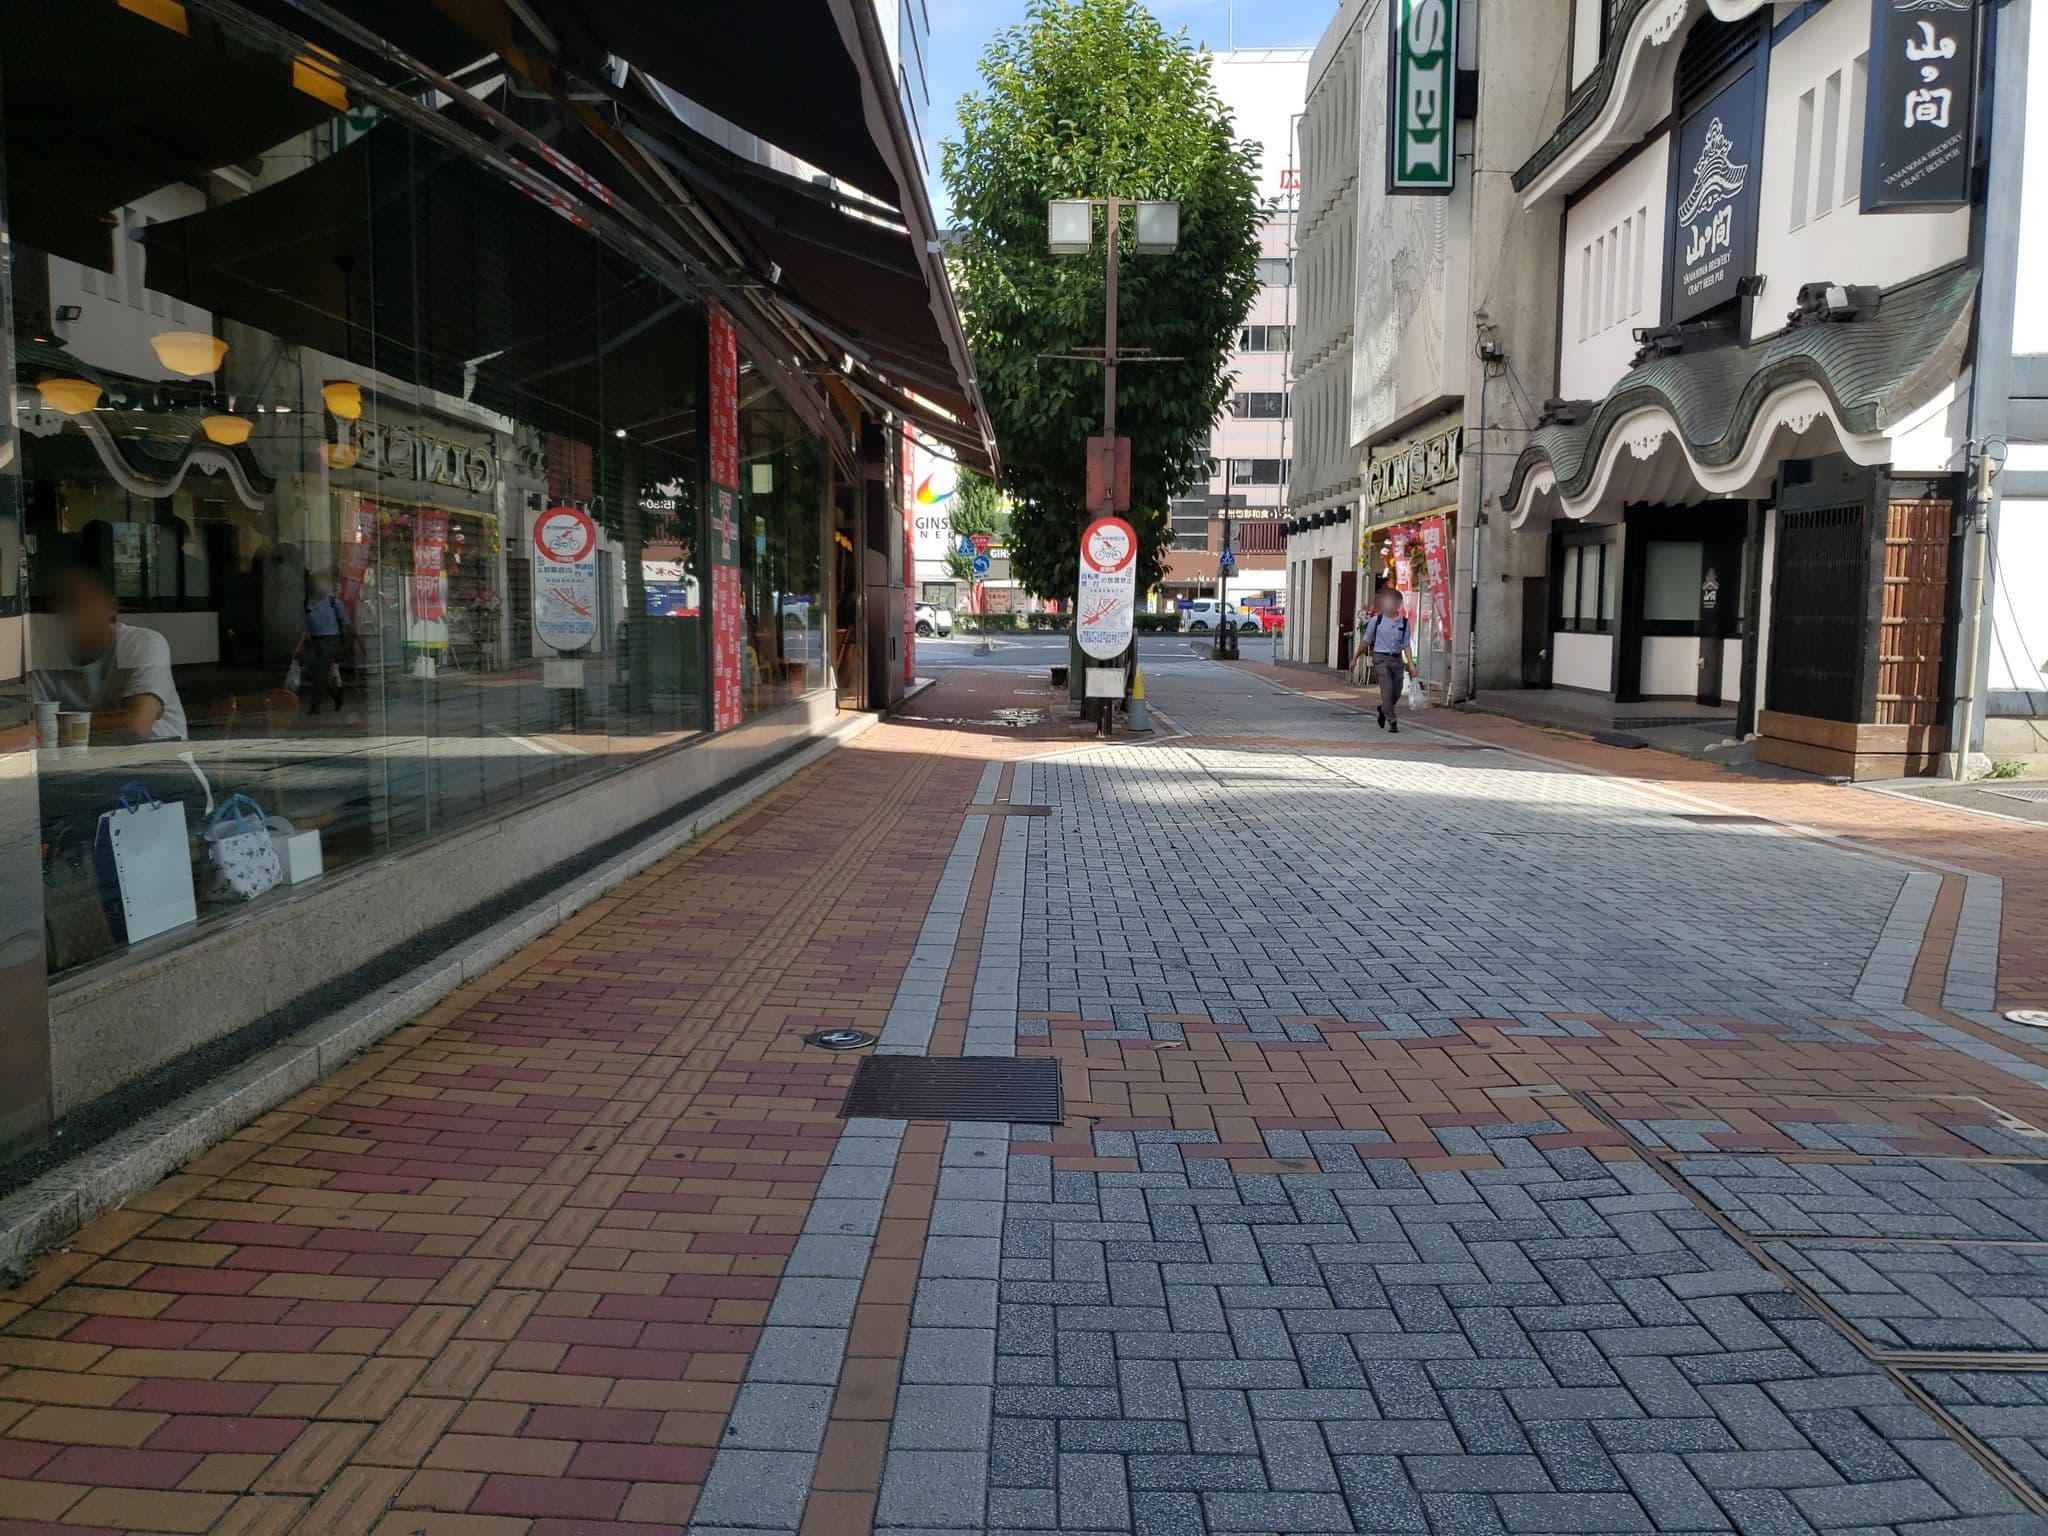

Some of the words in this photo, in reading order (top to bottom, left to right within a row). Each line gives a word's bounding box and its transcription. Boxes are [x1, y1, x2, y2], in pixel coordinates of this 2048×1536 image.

[1884, 155, 1927, 185] YAMANOMA
[1926, 130, 1963, 160] BREWERY
[1900, 169, 1925, 189] CRAFT
[1925, 157, 1946, 173] BEER
[1944, 148, 1960, 161] PUB
[1708, 252, 1730, 272] BREWERY
[1714, 269, 1724, 283] PUB
[1365, 426, 1463, 507] GINSEI
